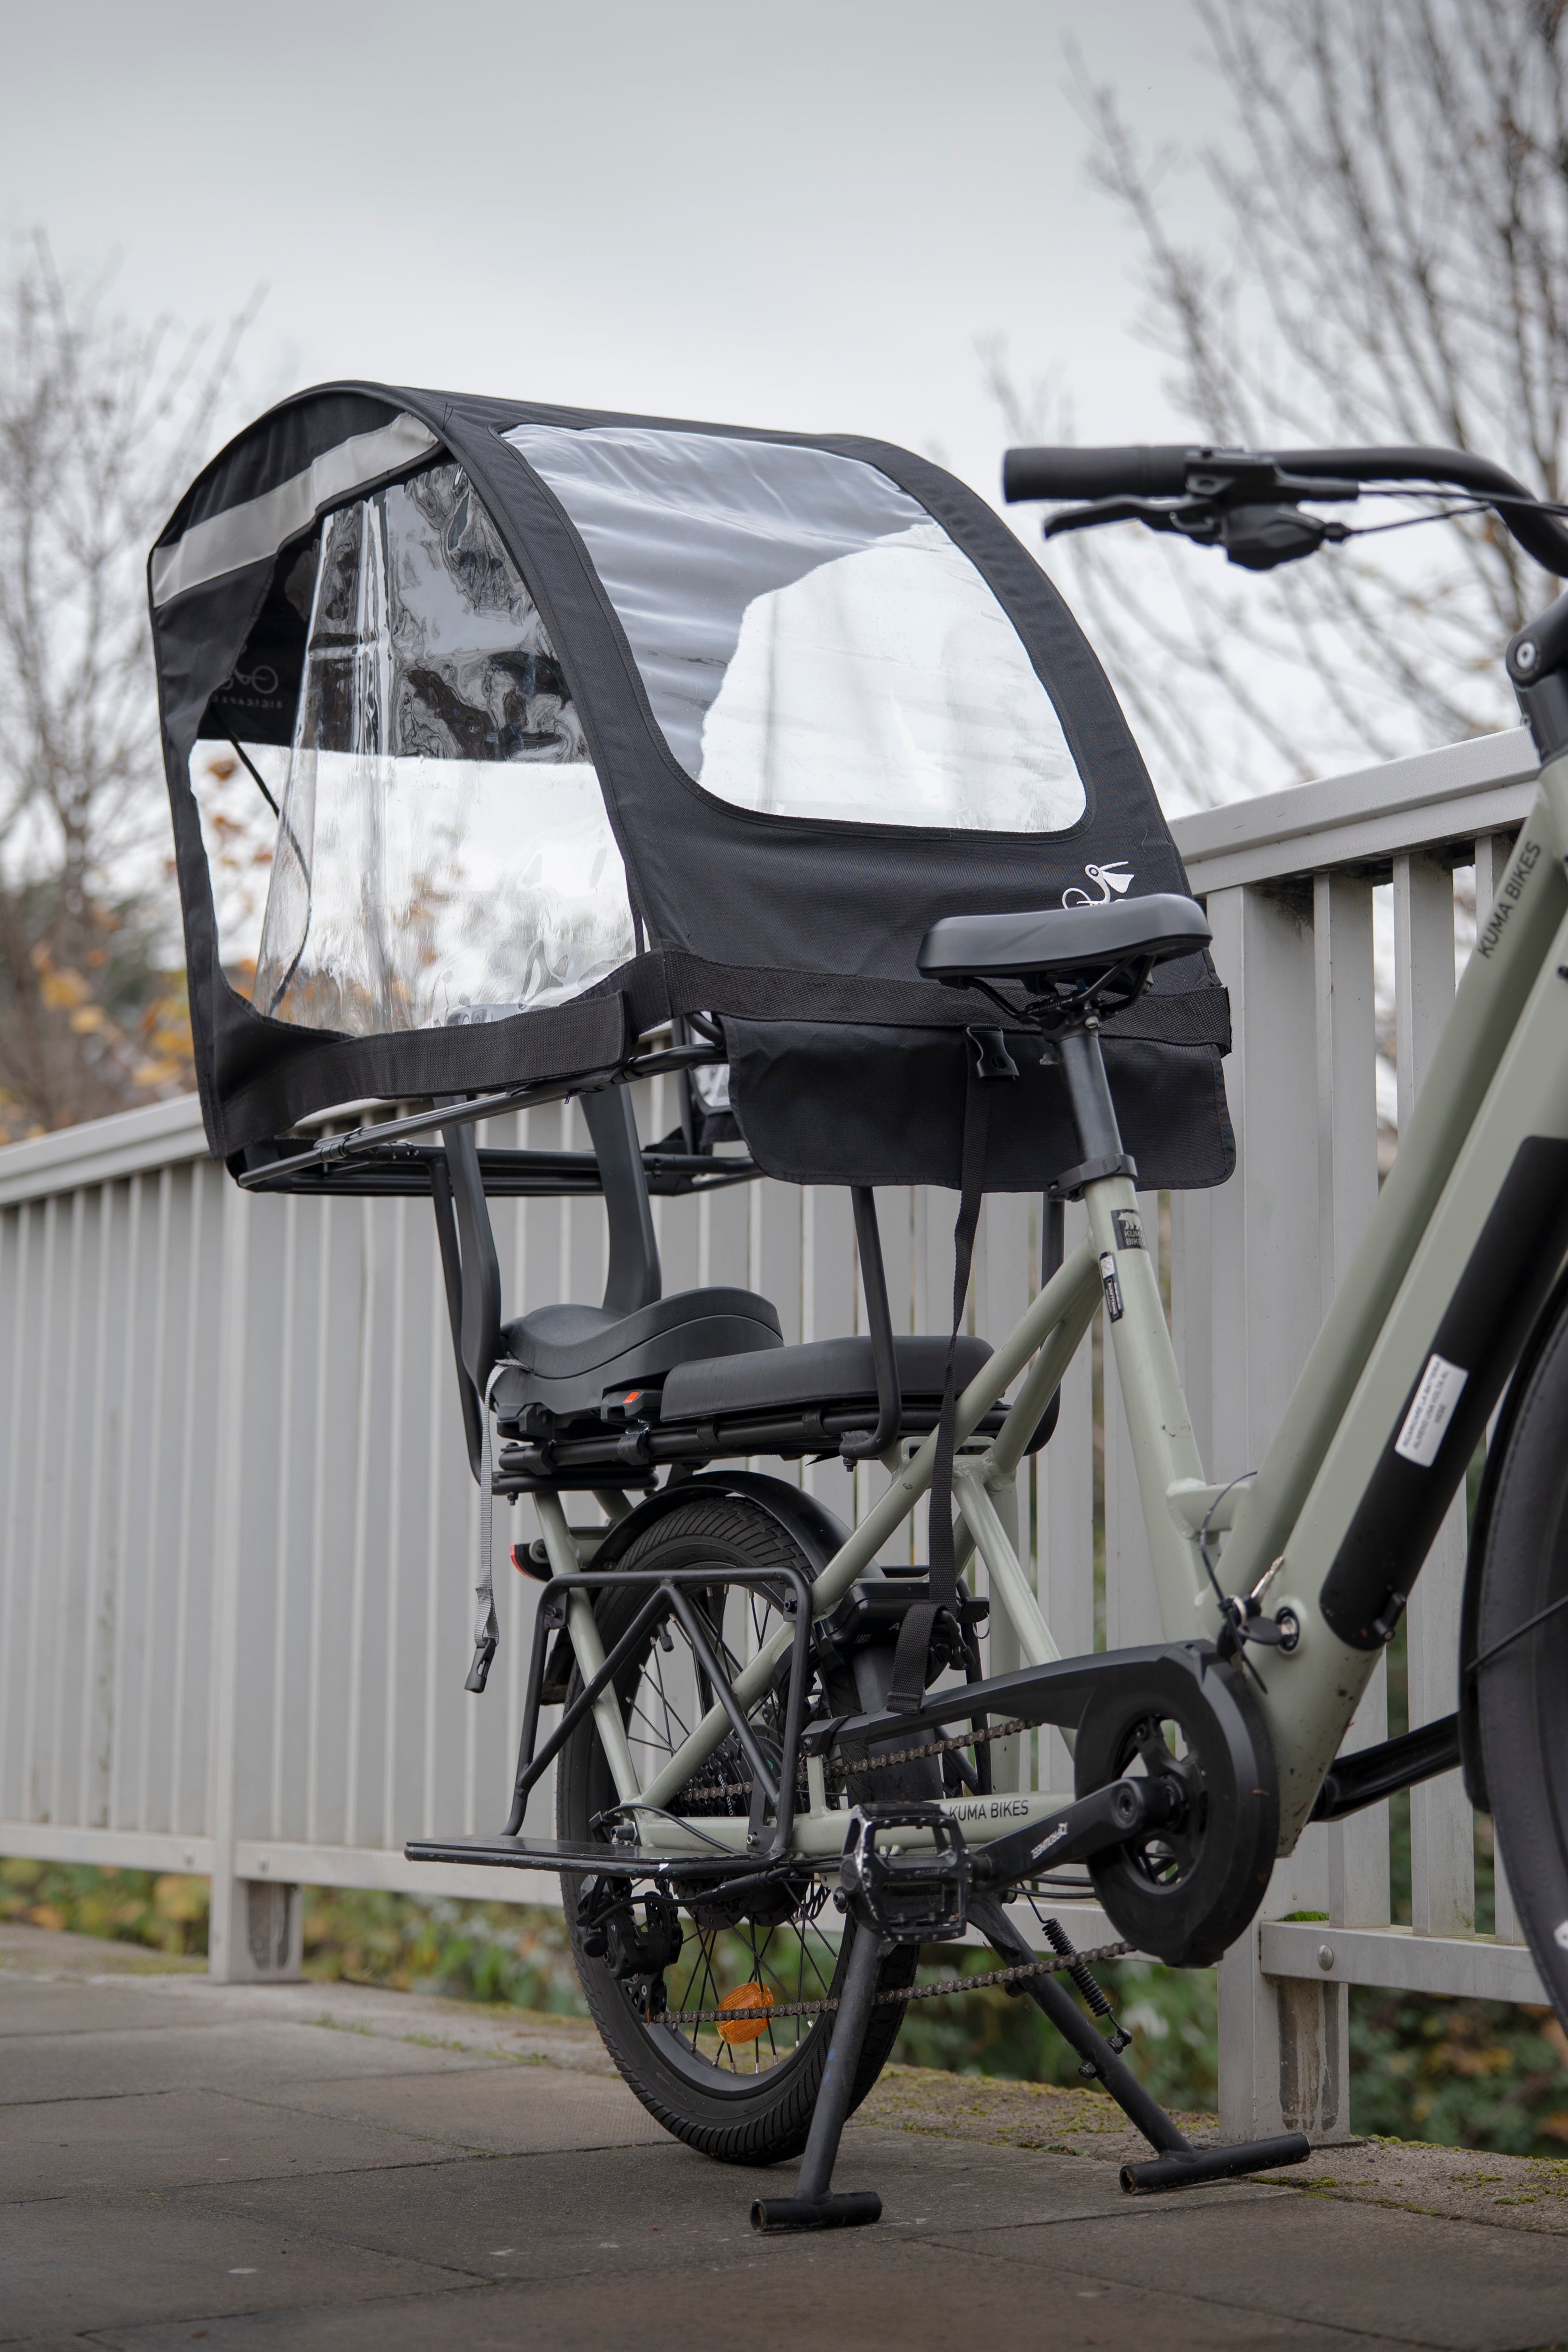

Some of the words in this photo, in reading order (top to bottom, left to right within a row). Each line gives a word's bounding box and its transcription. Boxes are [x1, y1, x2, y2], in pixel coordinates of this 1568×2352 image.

[1476, 902, 1514, 959] KUMA
[1505, 840, 1541, 901] BIKES
[950, 1804, 987, 1821] KUMA
[991, 1799, 1028, 1819] BIKES
